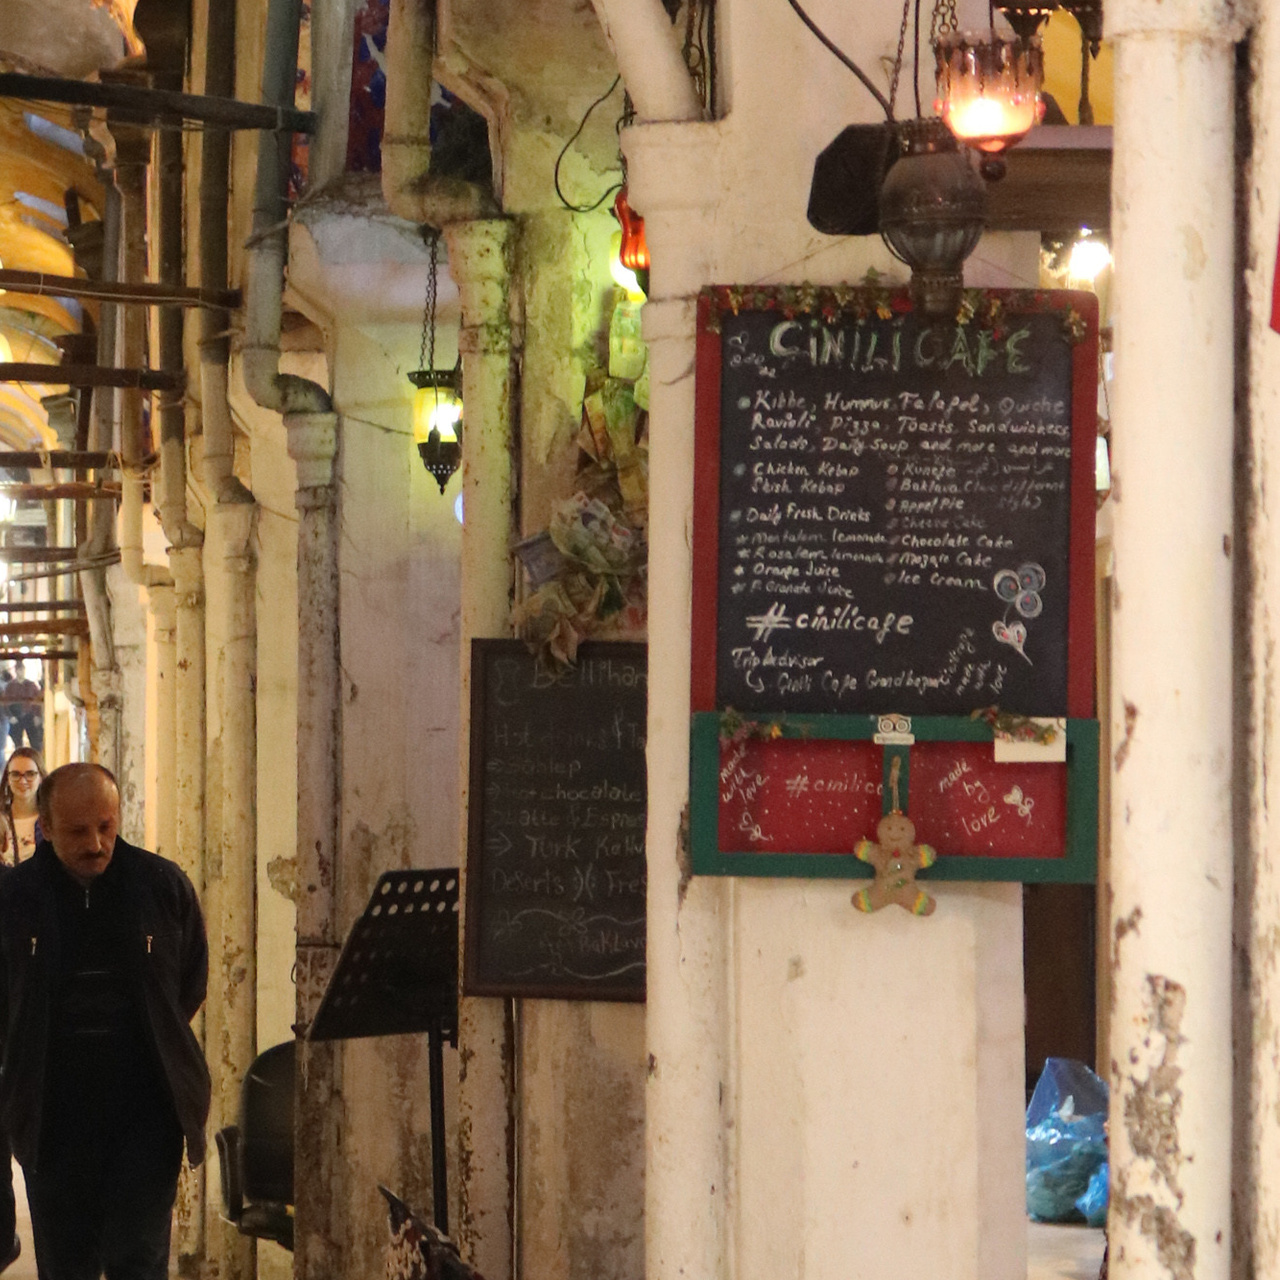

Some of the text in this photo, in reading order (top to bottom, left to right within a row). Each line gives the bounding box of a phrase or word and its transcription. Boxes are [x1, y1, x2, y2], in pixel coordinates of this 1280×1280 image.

[920, 438, 952, 452] and
[956, 442, 996, 453] more
[786, 502, 823, 521] Fresh
[828, 505, 871, 523] Drinks
[901, 533, 1014, 550] Chocolate Cake
[897, 570, 921, 585] Ice
